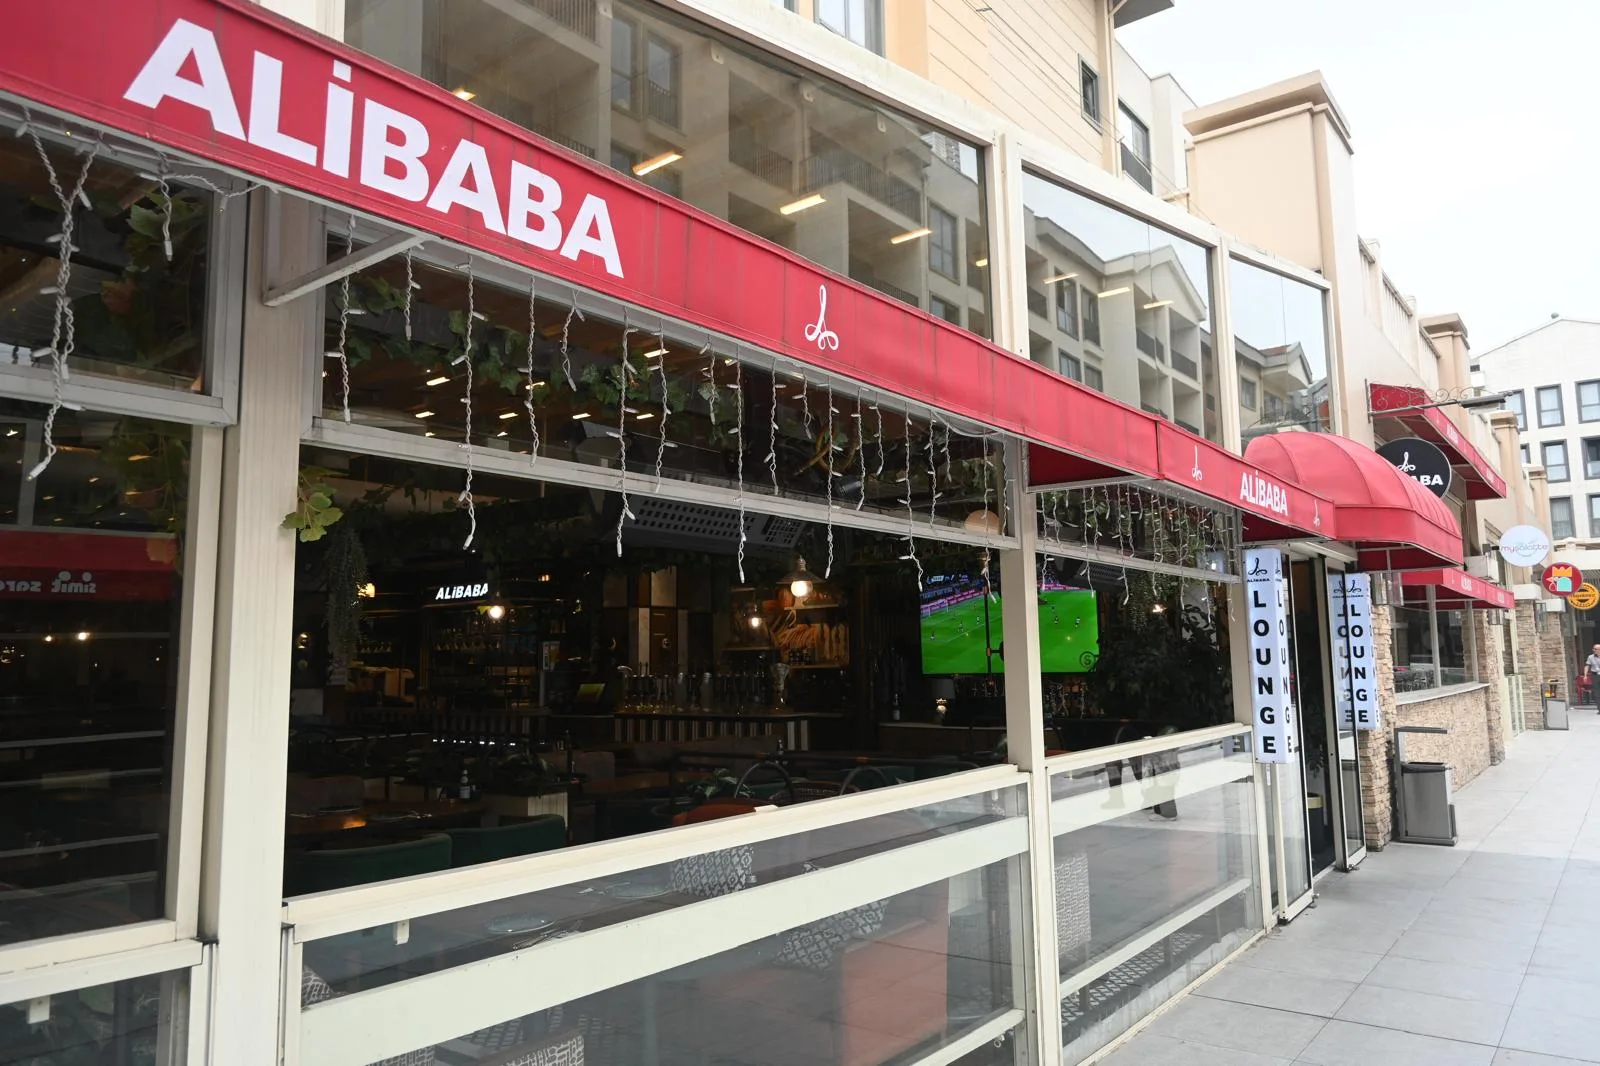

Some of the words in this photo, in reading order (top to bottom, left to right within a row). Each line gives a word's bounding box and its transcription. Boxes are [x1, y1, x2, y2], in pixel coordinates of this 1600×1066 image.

[1253, 590, 1277, 754] LOUNGE
[1276, 589, 1292, 753] LOUNGE
[1350, 603, 1369, 723] LOUNGE
